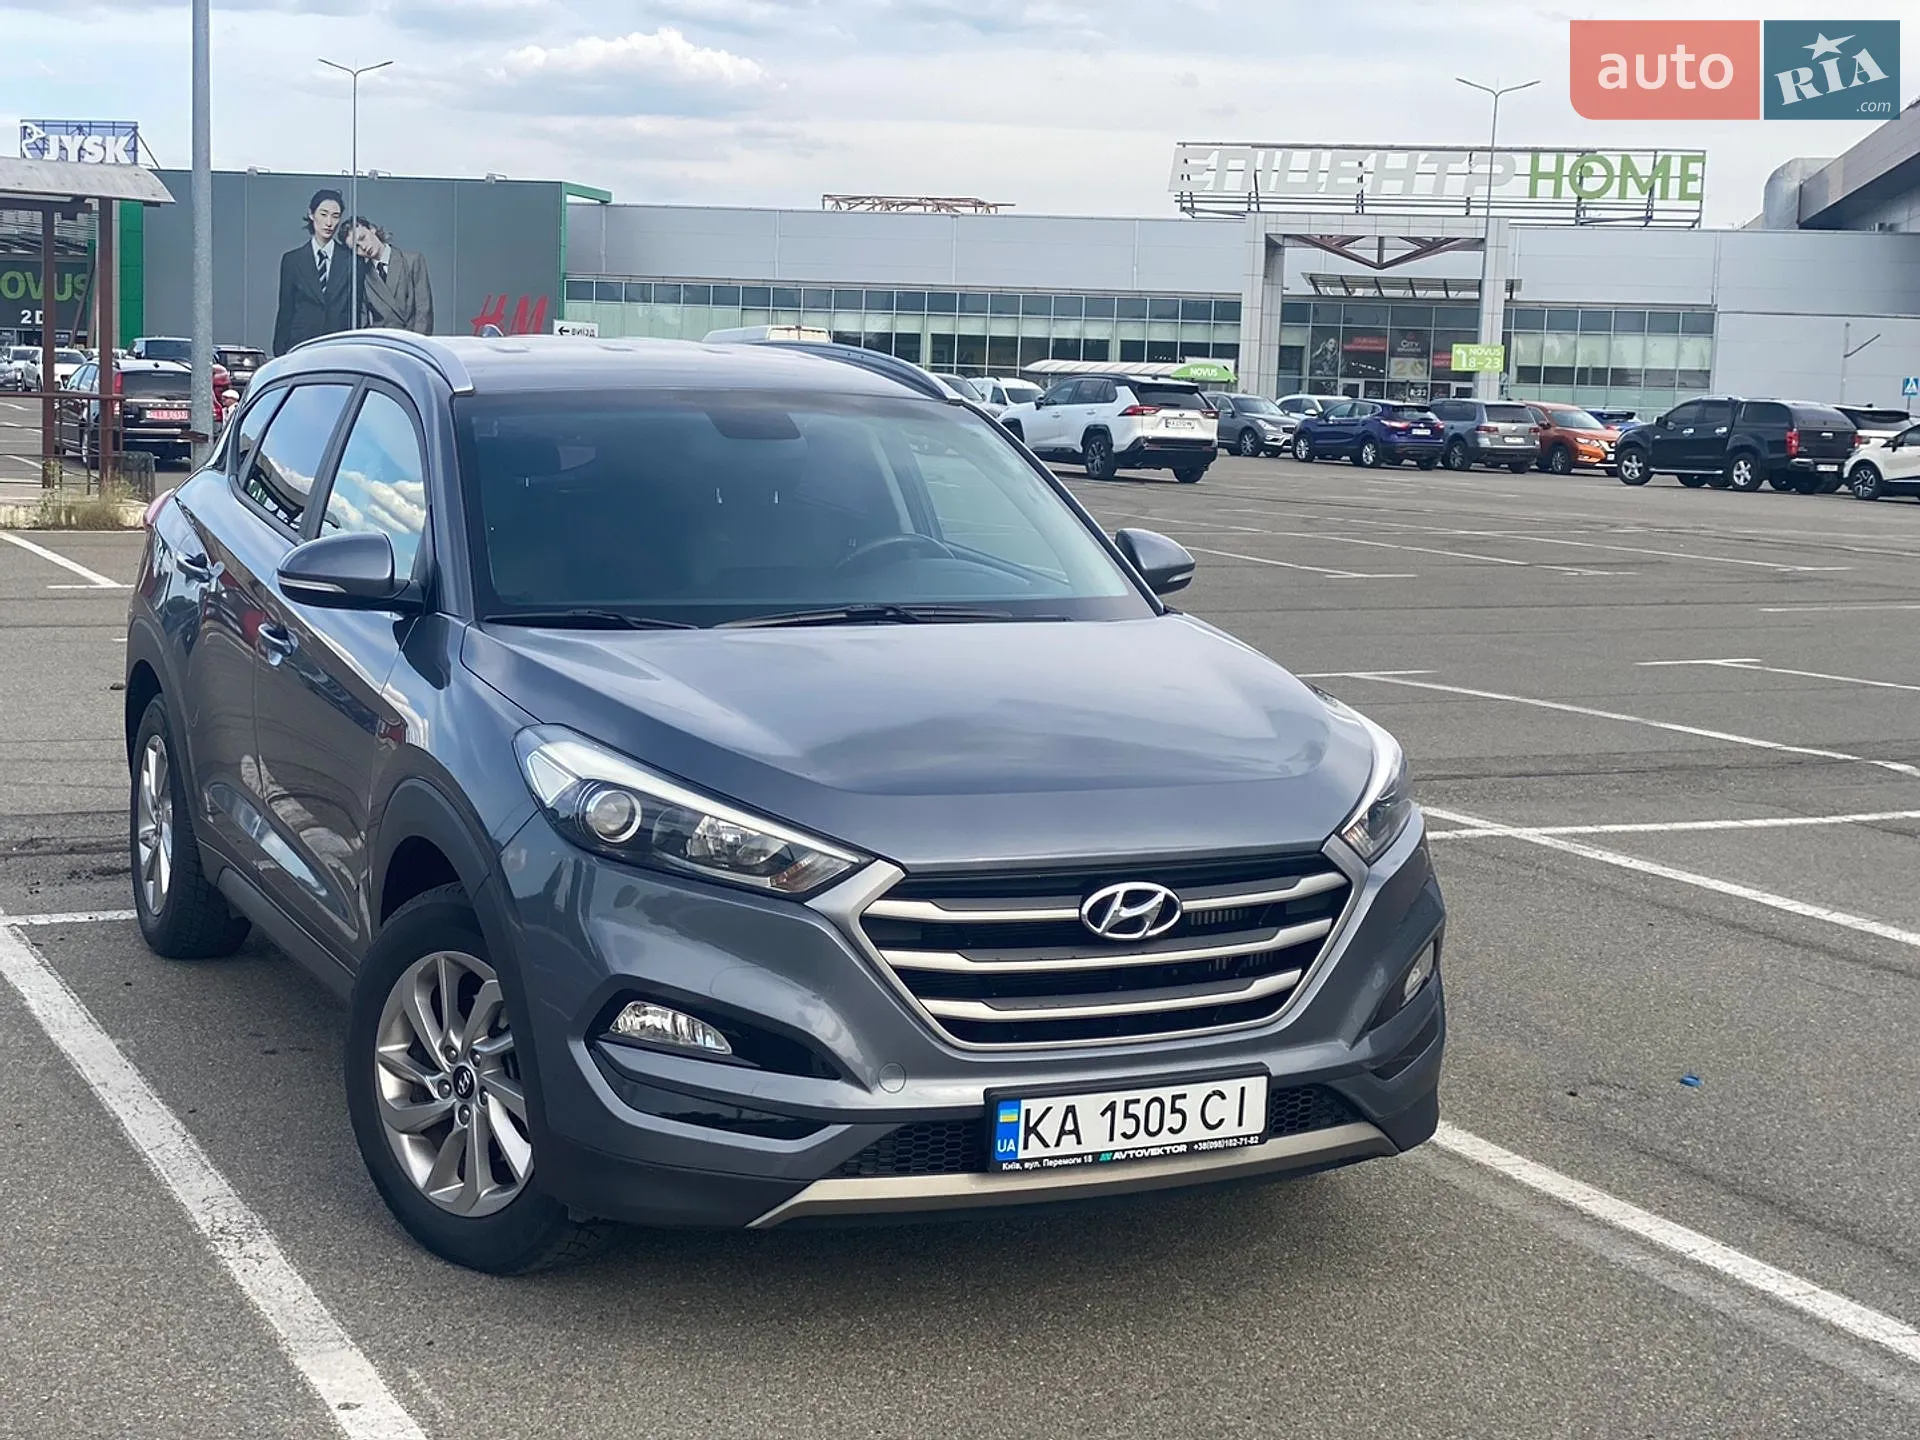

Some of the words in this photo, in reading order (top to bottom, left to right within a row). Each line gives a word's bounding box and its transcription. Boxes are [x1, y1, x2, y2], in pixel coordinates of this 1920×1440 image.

[44, 135, 132, 164] JYSK
[1168, 148, 1517, 198] ЕПІЦЕНТР
[1528, 152, 1706, 201] HOME
[1469, 347, 1502, 357] NOVUS
[1190, 367, 1218, 377] NOVUS
[1023, 1104, 1083, 1151] KA
[1099, 1092, 1188, 1143] 1505
[997, 1138, 1016, 1153] UA
